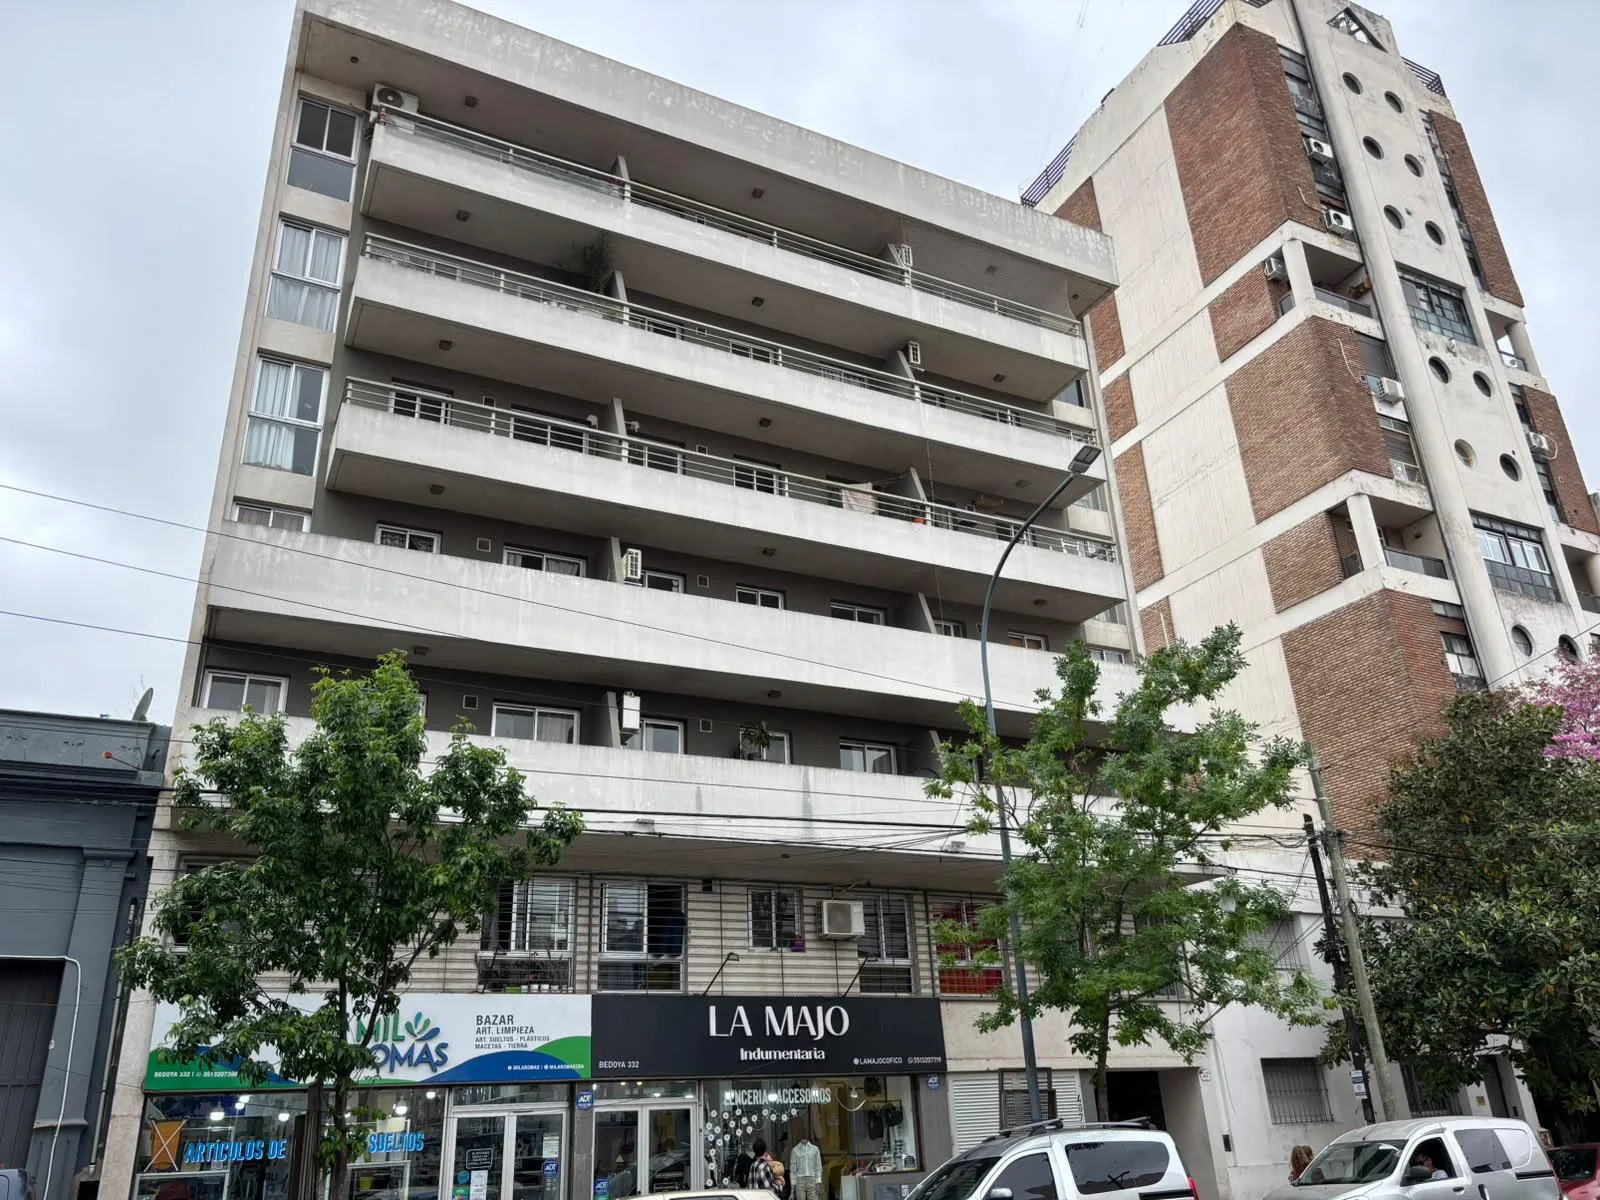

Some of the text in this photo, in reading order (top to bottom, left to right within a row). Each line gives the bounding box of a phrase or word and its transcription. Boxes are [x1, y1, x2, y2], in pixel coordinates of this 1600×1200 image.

[356, 1009, 405, 1041] MIL
[476, 1014, 514, 1026] BAZAR
[708, 1005, 850, 1041] LA MAJO
[475, 1025, 535, 1035] ART. LIMPIEZA
[740, 1047, 825, 1061] Indumentaria
[598, 1061, 640, 1069] BEDOYA 332
[578, 1094, 592, 1103] ADT
[723, 1087, 832, 1106] LENCERIA ACCESORIOS
[267, 1139, 288, 1159] DE
[367, 1131, 425, 1153] SUELTOS
[544, 1163, 558, 1171] ADT
